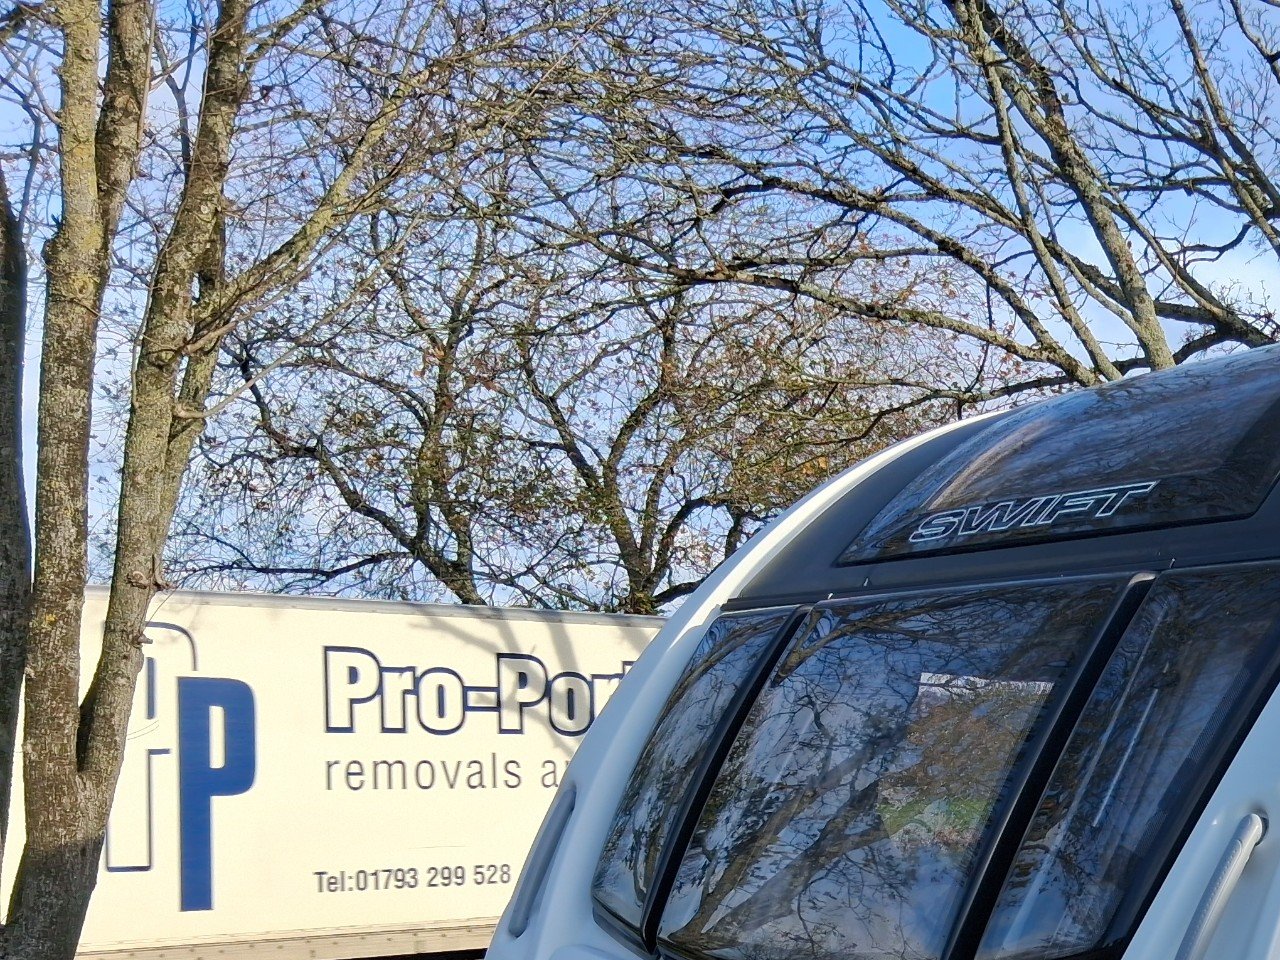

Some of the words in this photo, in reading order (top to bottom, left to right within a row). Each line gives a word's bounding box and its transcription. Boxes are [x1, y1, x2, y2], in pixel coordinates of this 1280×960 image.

[909, 479, 1161, 542] SWIFT
[323, 645, 636, 736] Pro-Por
[325, 752, 521, 791] removals
[541, 759, 569, 788] a
[313, 867, 418, 893] Tel:01793
[427, 865, 465, 888] 299
[473, 863, 511, 886] 528
